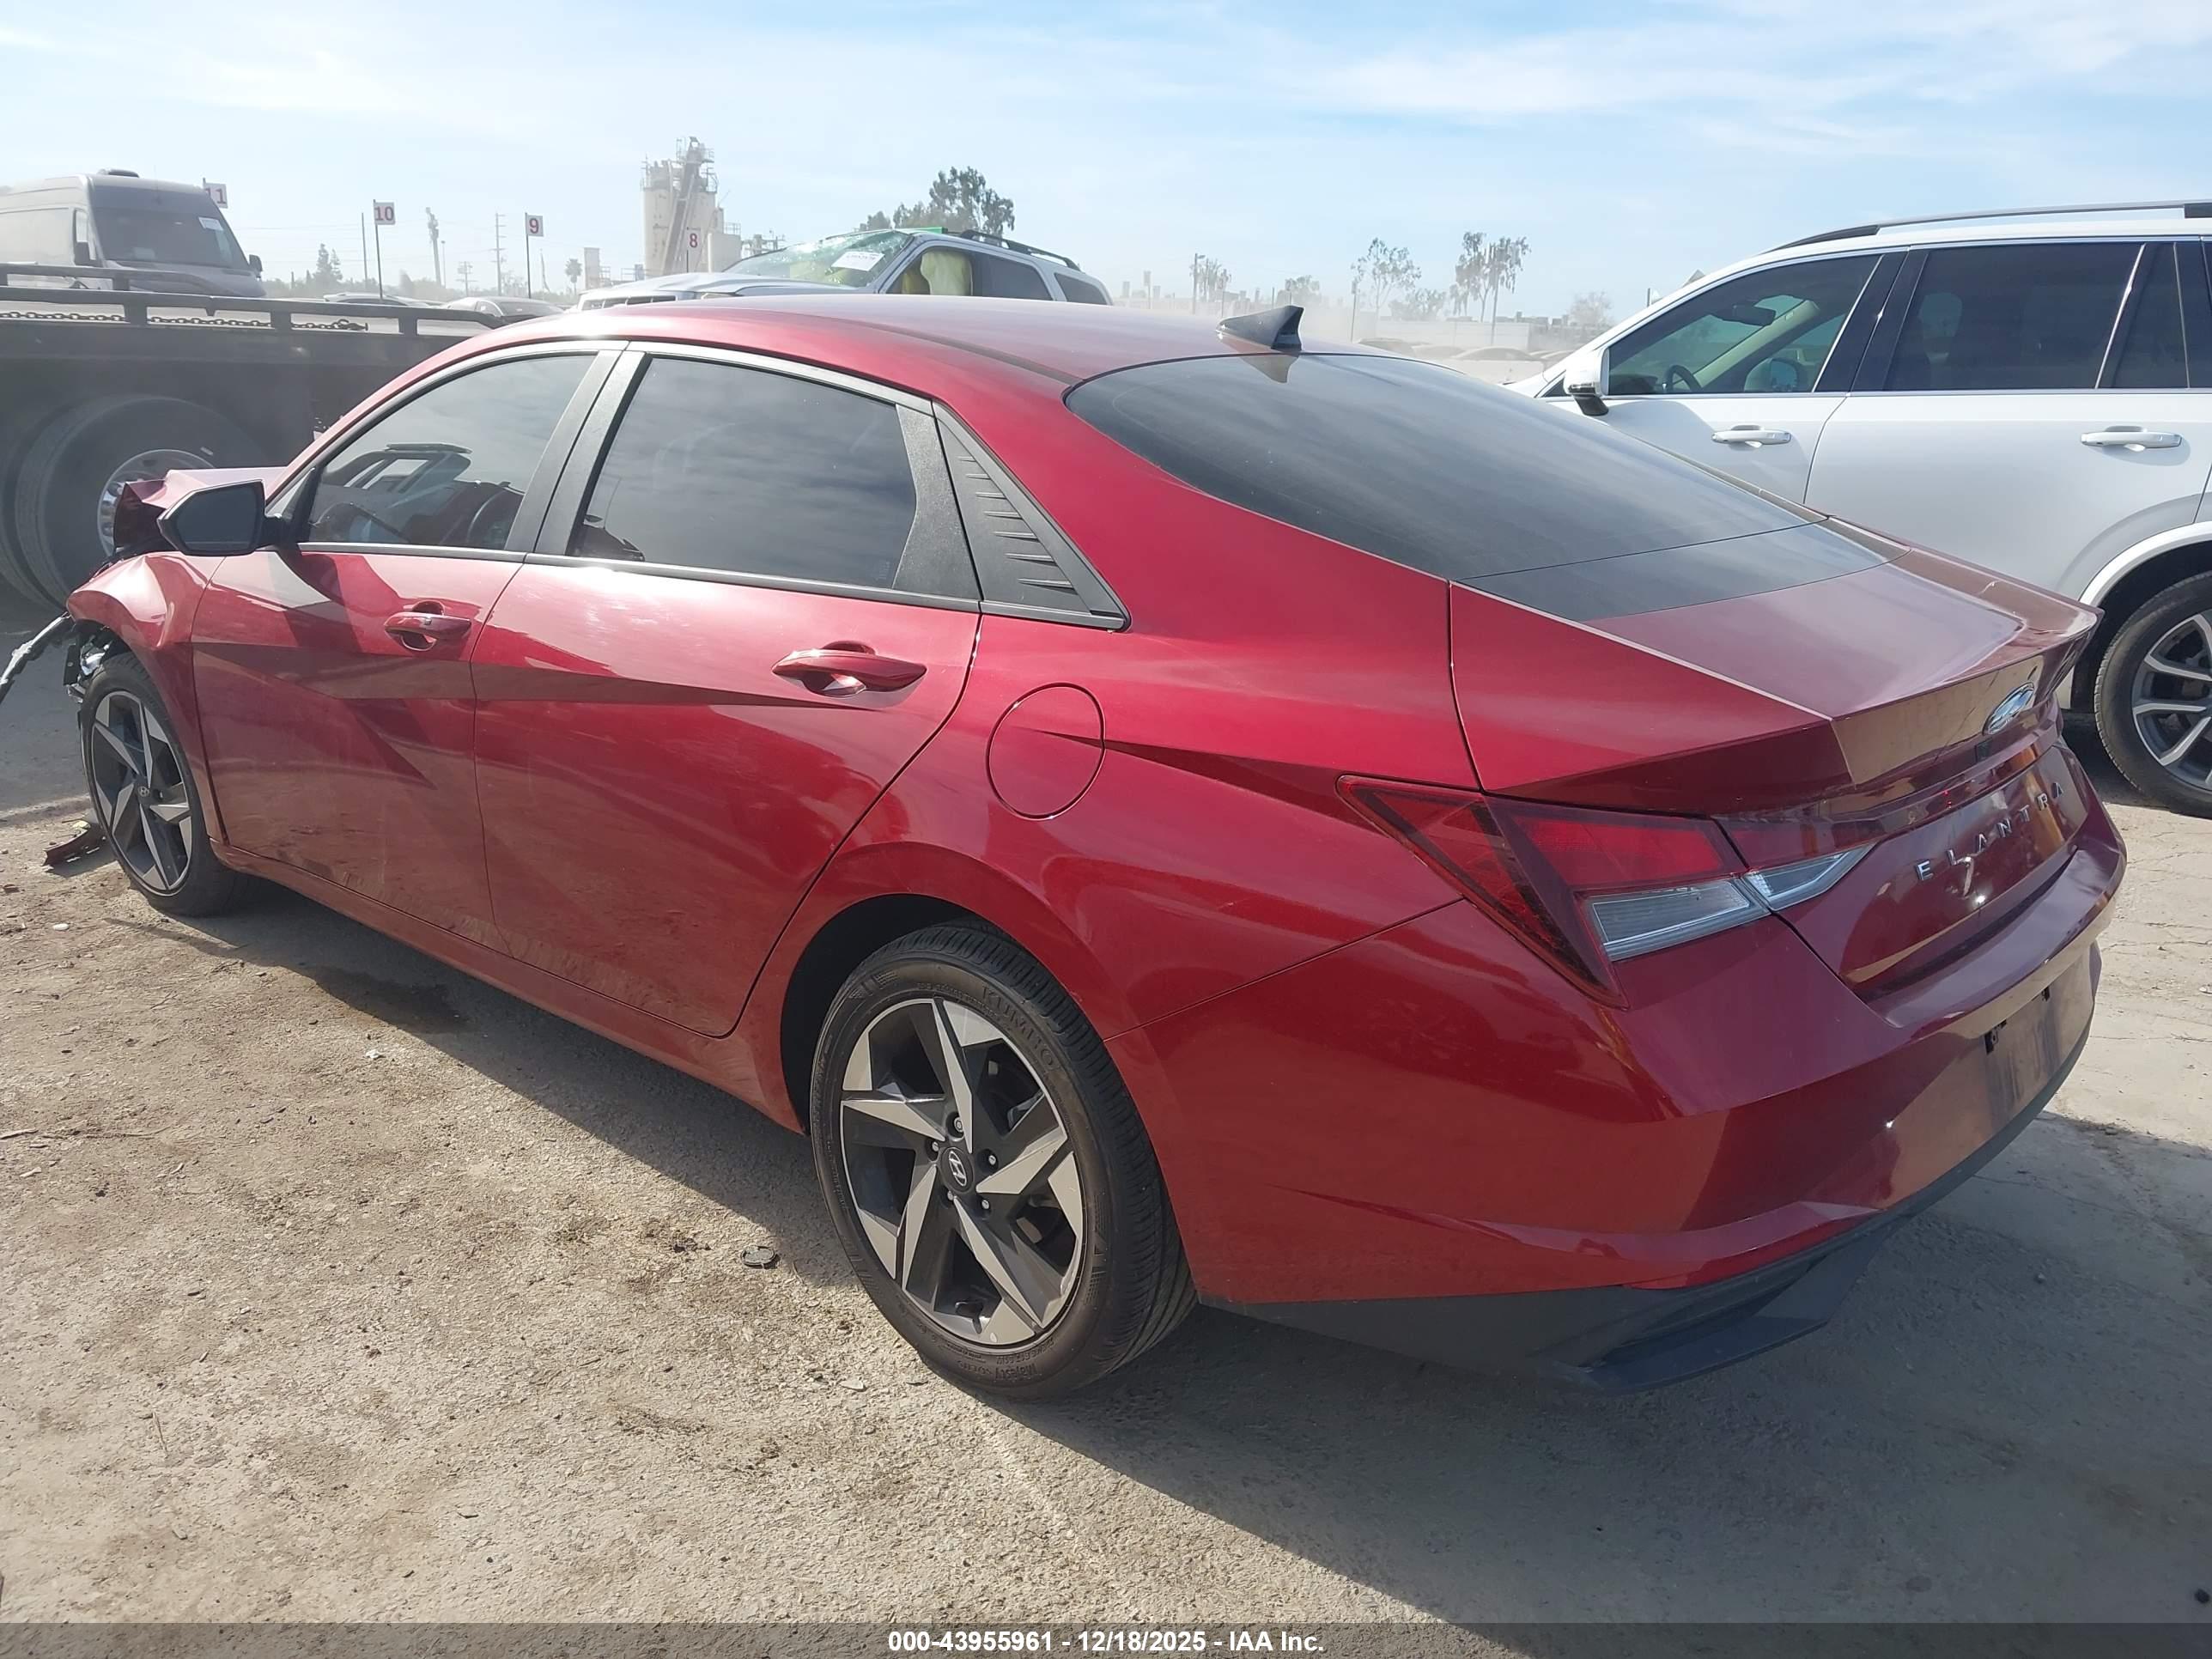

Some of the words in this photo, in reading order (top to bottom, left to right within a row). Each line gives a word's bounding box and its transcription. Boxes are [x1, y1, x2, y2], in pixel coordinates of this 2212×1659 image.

[374, 205, 395, 221] 10
[529, 217, 539, 234] 9
[690, 233, 698, 248] 8
[1916, 782, 2064, 881] ELANTRA
[982, 986, 1054, 1066] KUMHO
